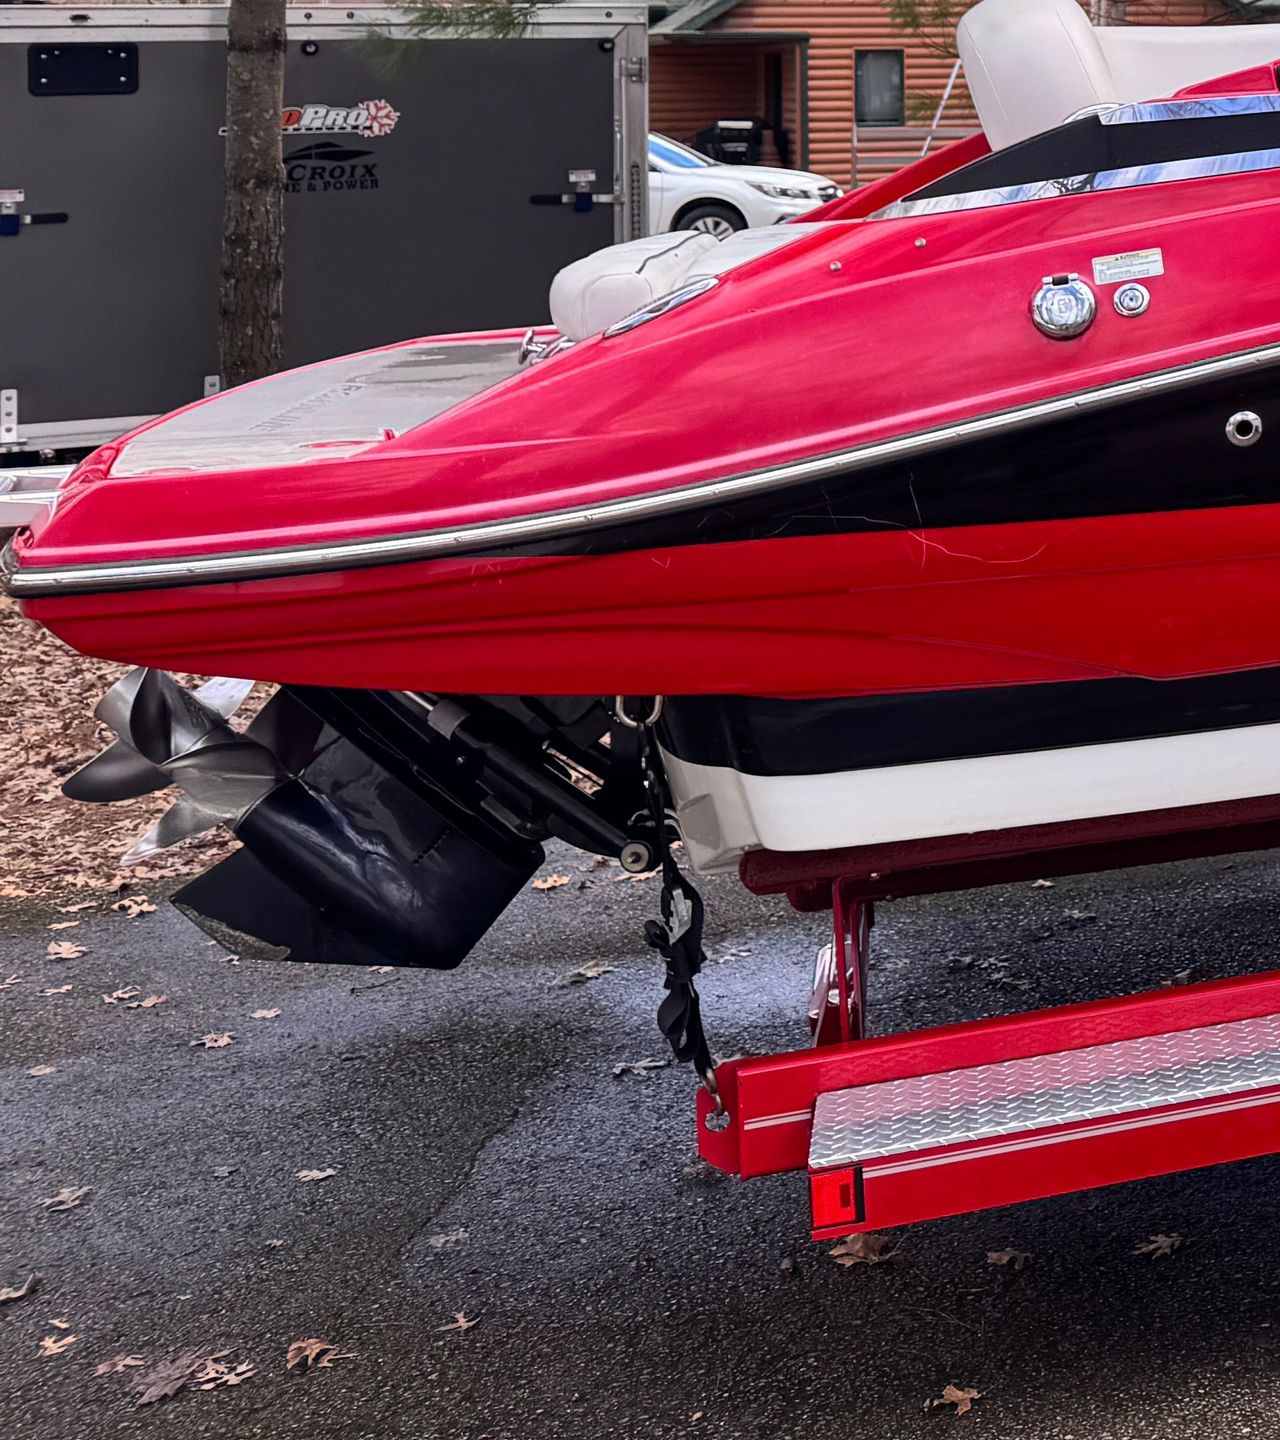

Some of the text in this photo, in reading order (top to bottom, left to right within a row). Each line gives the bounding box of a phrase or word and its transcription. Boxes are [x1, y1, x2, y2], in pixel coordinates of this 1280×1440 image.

[282, 106, 369, 129] OPRO
[287, 164, 378, 181] CROIX
[323, 179, 379, 191] POWER
